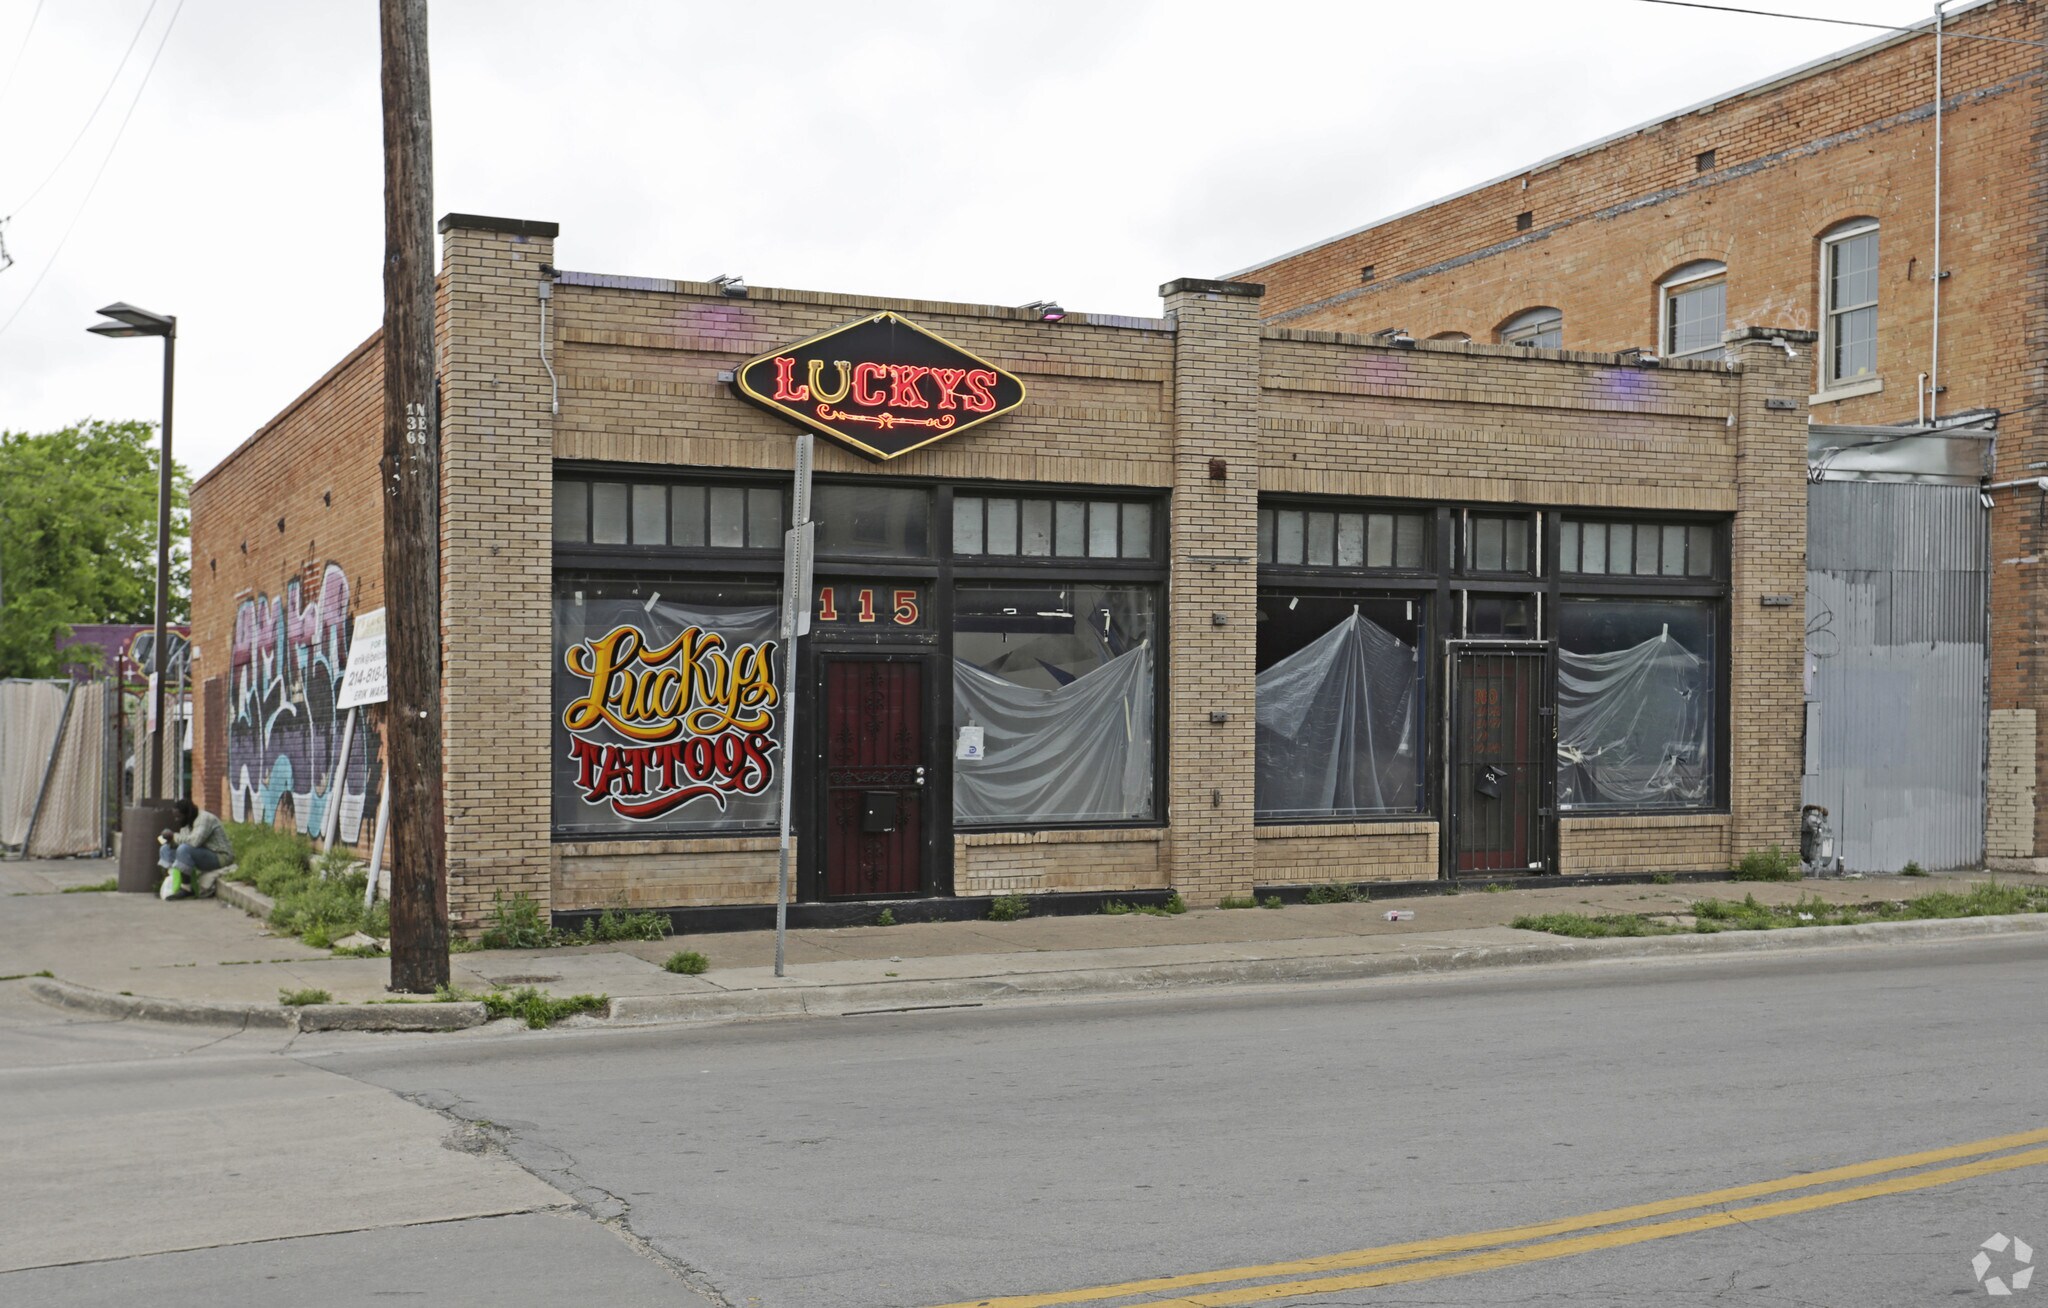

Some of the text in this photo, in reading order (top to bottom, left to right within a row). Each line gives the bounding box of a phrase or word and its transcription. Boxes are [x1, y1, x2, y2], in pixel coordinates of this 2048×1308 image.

[772, 355, 998, 413] LUCKYS
[405, 402, 425, 417] 1N
[406, 416, 427, 430] 3E
[406, 431, 427, 445] 68
[818, 586, 920, 626] 115
[563, 624, 779, 742] Luckys
[353, 689, 368, 701] ERIK
[1475, 688, 1498, 704] NO
[569, 729, 780, 806] TATTOOS
